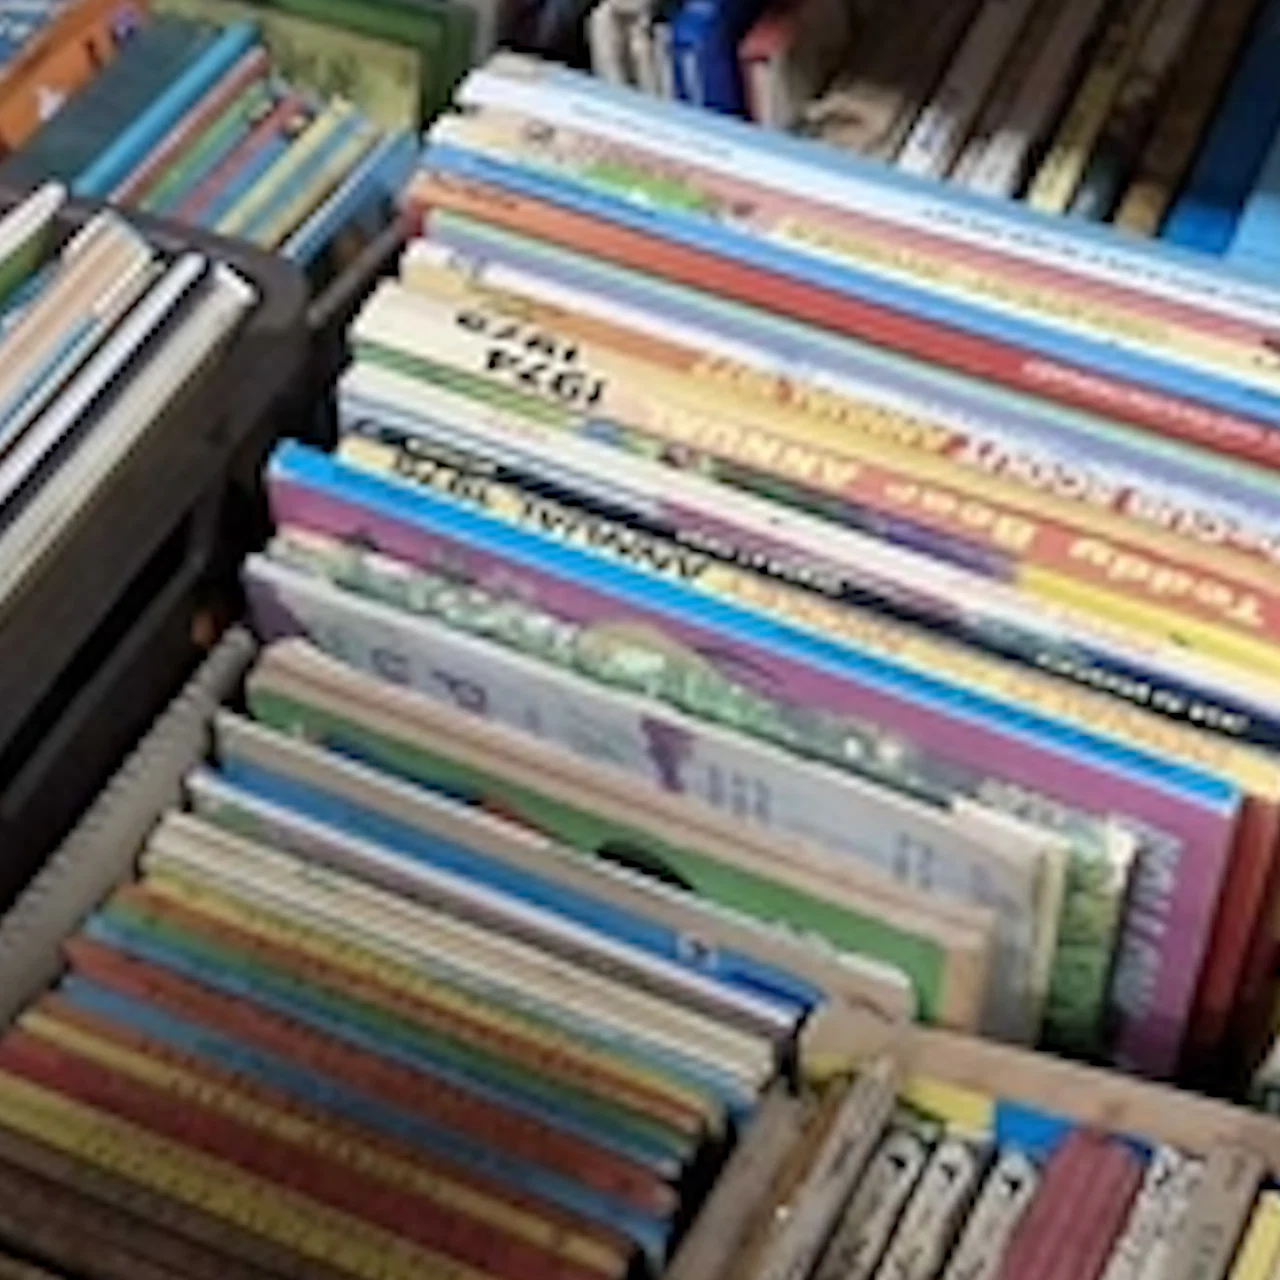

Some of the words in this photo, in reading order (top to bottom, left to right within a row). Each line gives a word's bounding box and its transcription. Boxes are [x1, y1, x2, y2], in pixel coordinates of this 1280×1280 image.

[486, 348, 607, 406] 1974
[638, 400, 861, 488] ANNUAL
[882, 481, 1036, 552] Bear
[1066, 532, 1265, 627] Teddy
